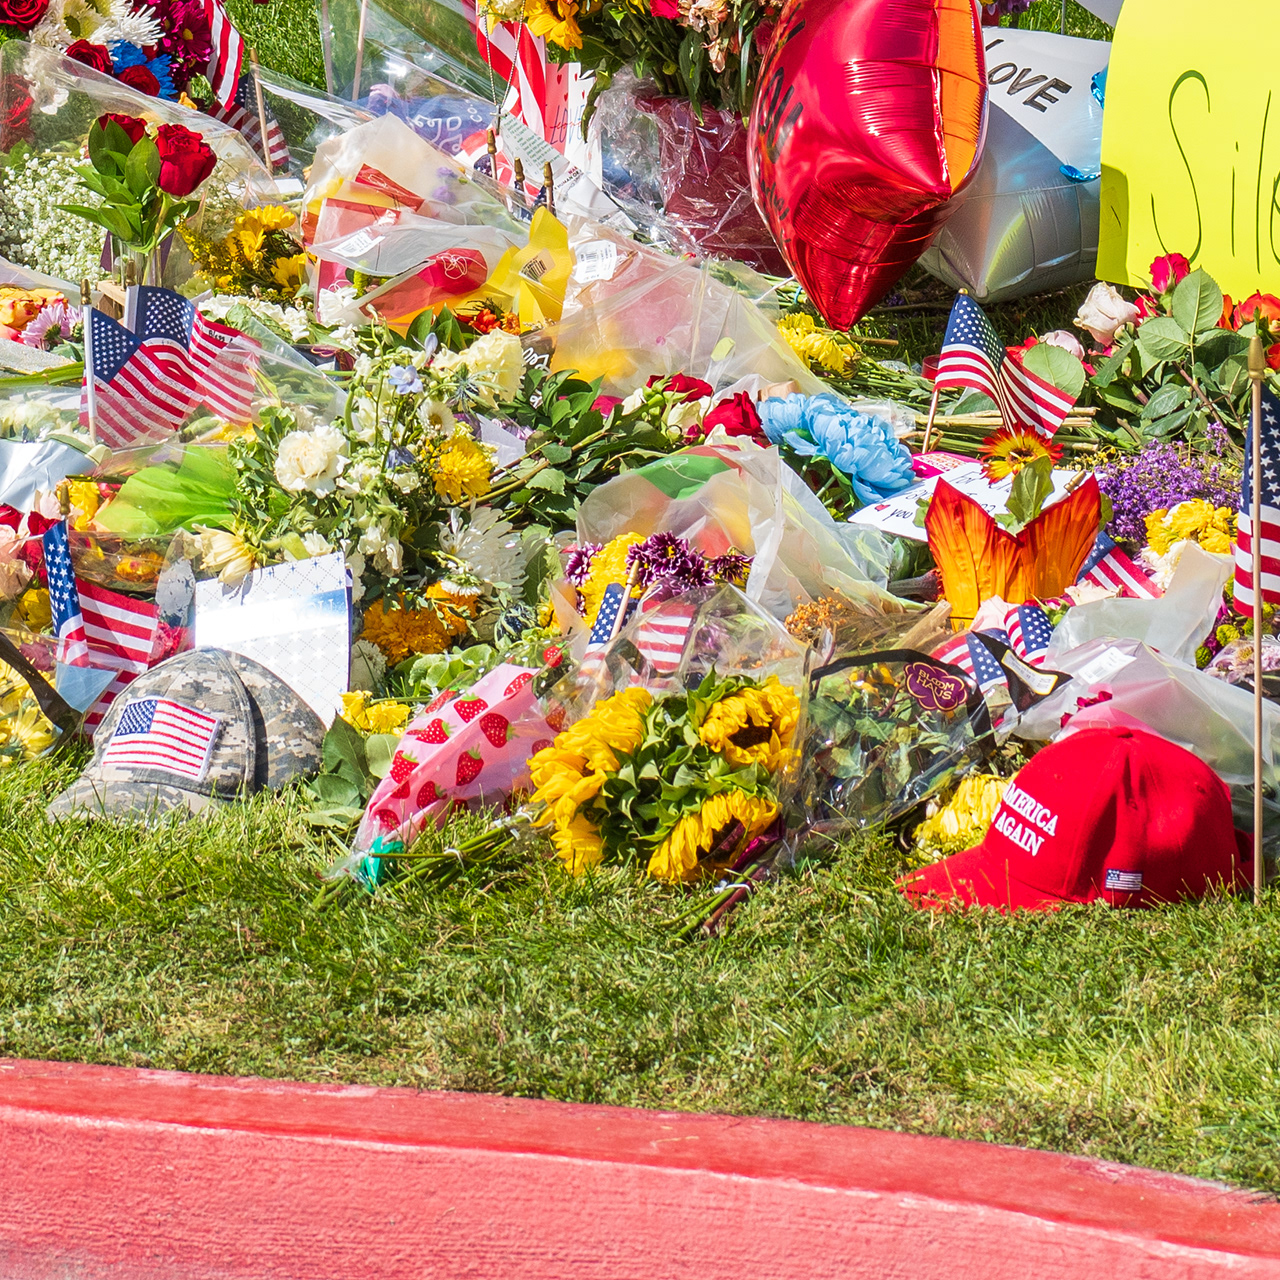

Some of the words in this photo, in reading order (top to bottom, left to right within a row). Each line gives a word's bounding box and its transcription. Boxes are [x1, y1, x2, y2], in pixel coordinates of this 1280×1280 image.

[985, 38, 1072, 113] OVE
[916, 677, 953, 701] HAUS
[918, 669, 956, 690] BLOOM
[994, 811, 1045, 856] AGAIN
